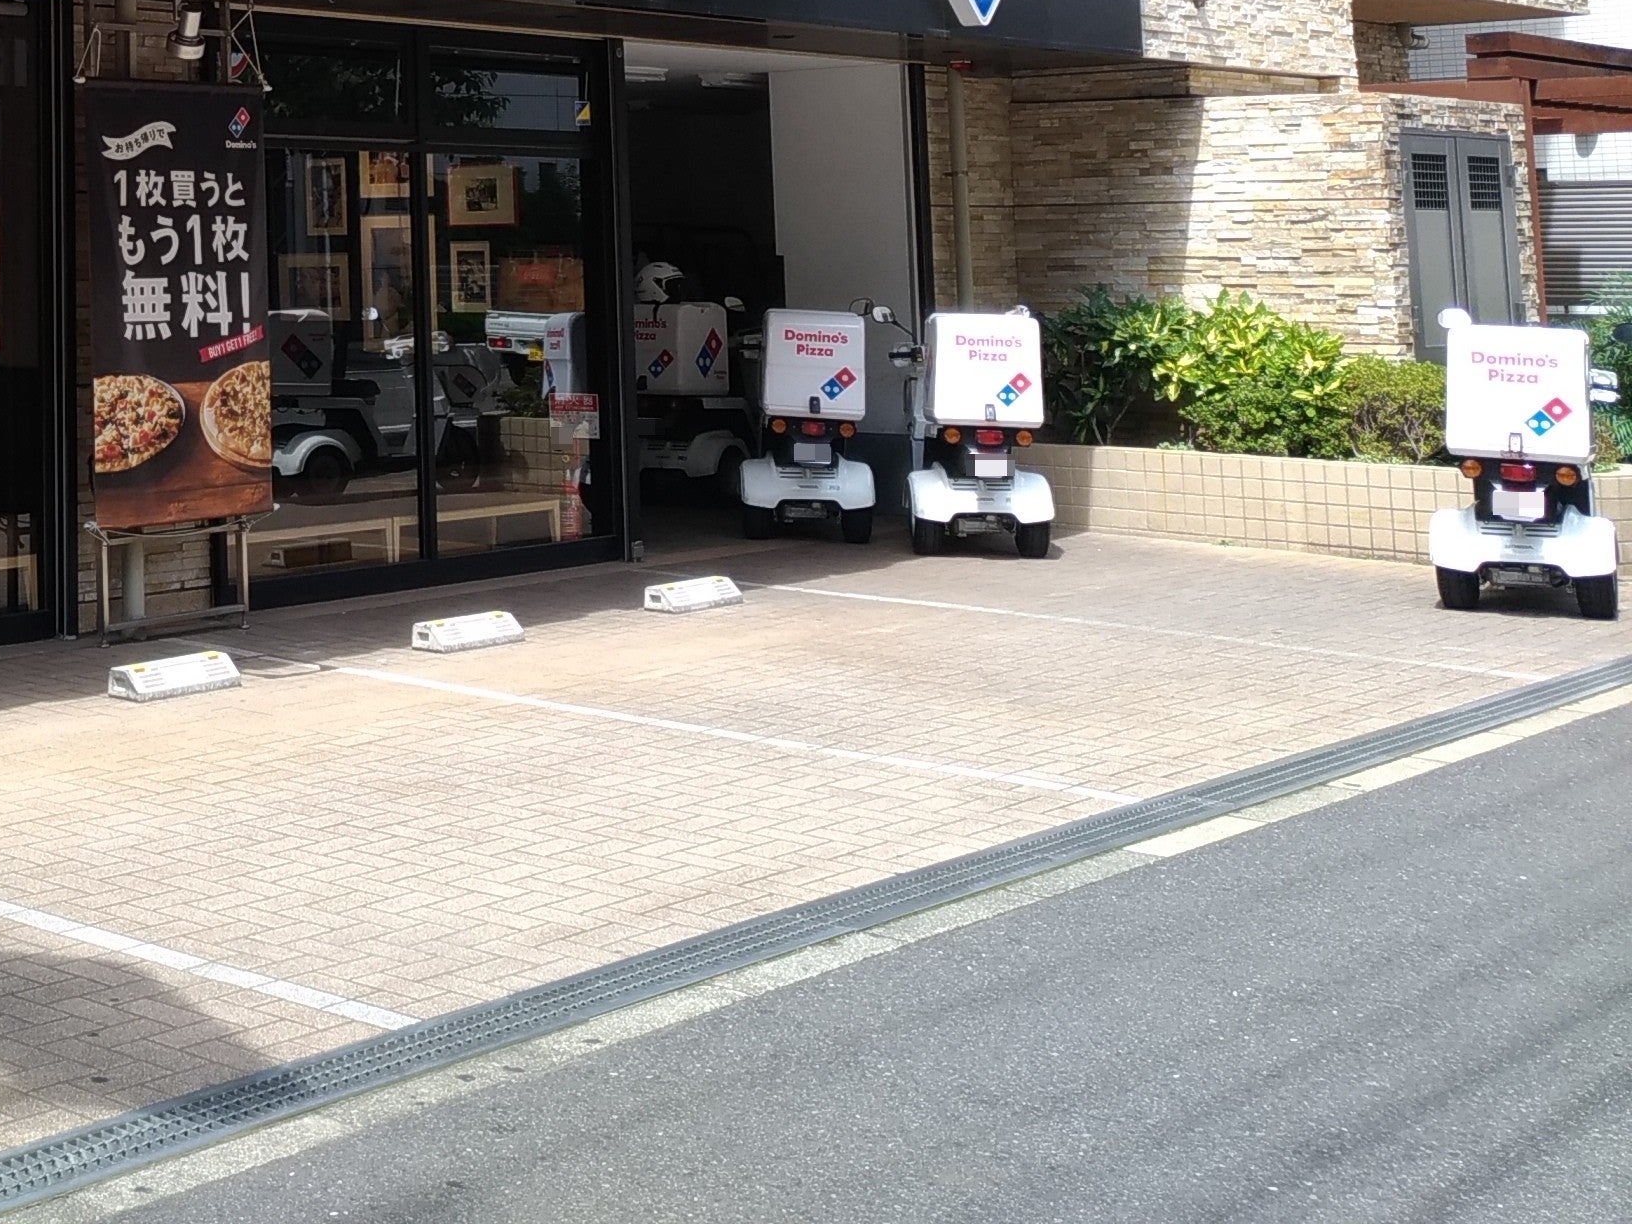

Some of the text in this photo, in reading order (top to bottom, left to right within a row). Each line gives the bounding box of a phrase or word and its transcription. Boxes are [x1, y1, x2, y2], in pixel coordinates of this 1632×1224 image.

[114, 127, 167, 155] お持ち帰りで
[225, 140, 258, 150] Domino's
[113, 169, 246, 208] 1枚買うと
[118, 214, 250, 266] もう1枚
[121, 269, 251, 341] 無料!
[634, 318, 667, 329] mino's
[634, 330, 657, 341] izza
[784, 329, 849, 345] Domino's
[955, 334, 1023, 349] Domino's
[796, 343, 834, 357] Pizza
[968, 349, 1008, 362] Pizza
[1471, 351, 1559, 368] Domino's
[1487, 369, 1539, 384] Pizza
